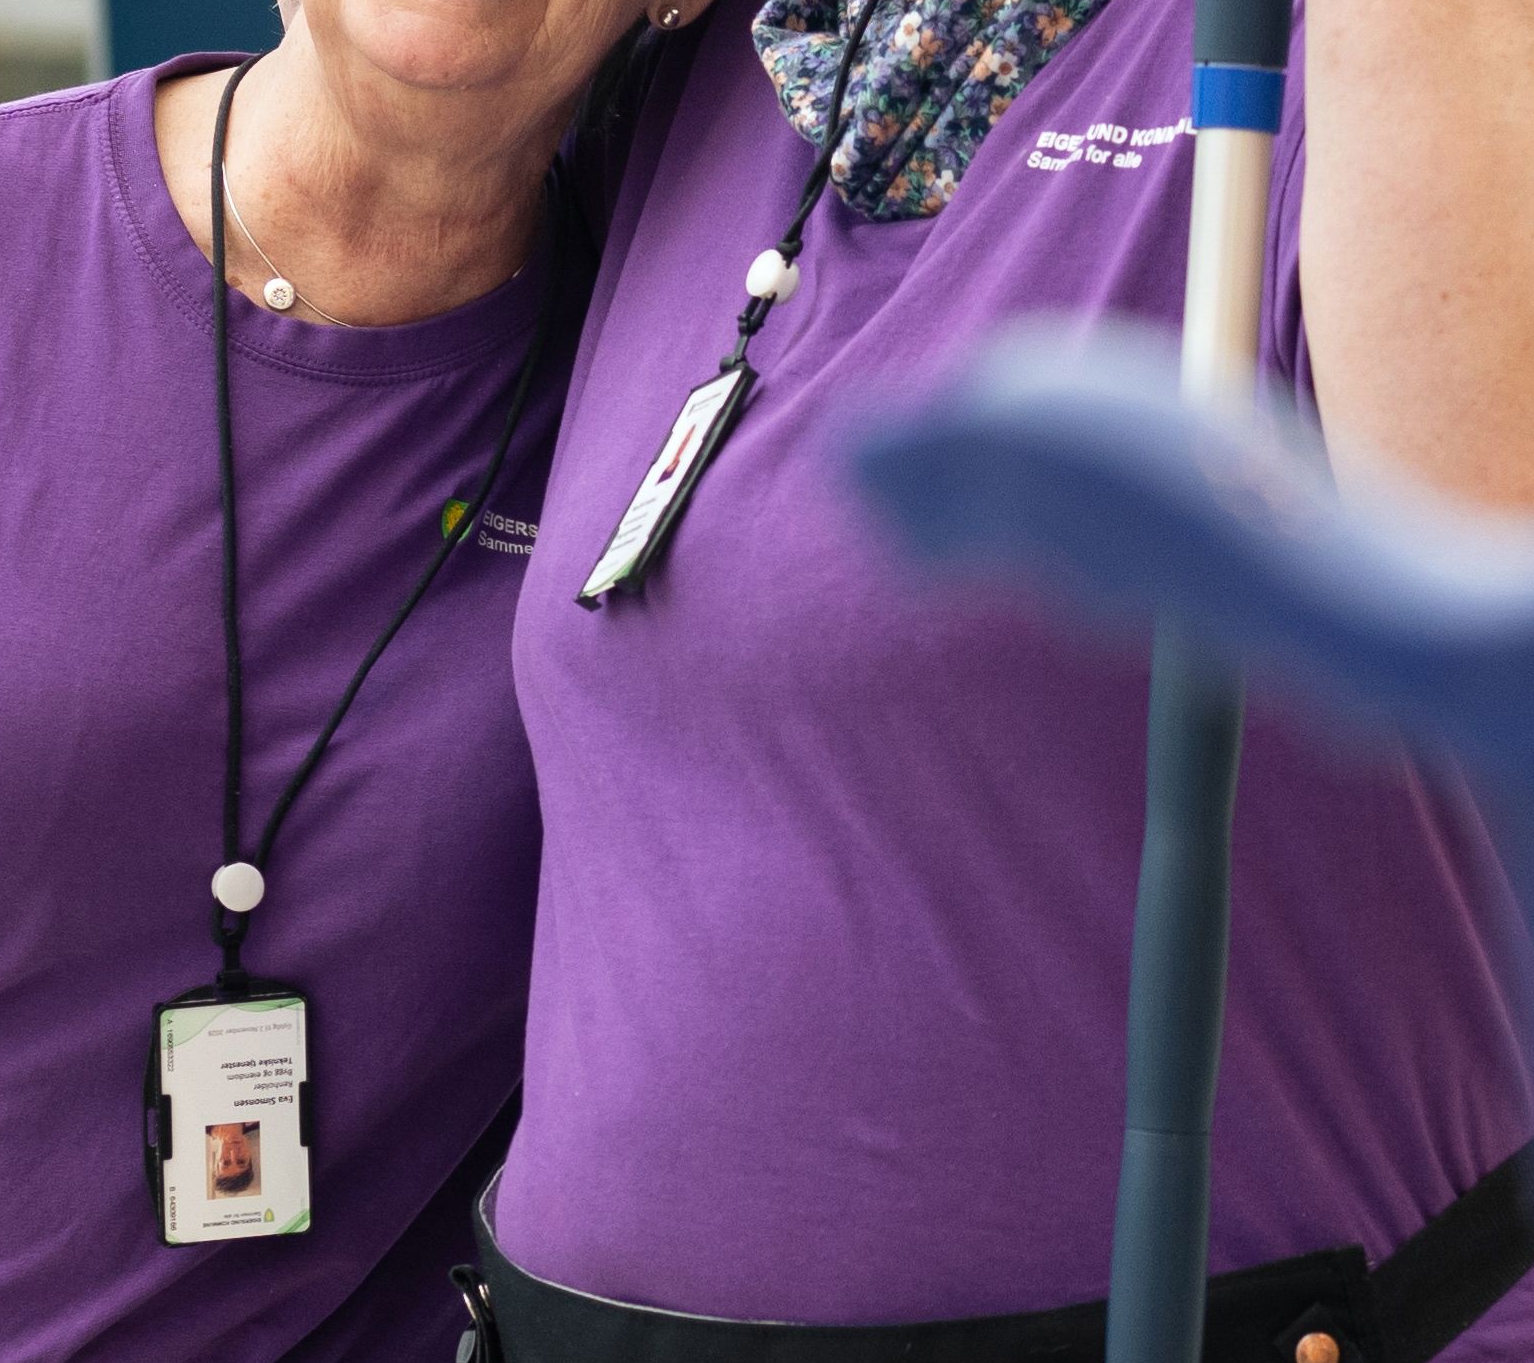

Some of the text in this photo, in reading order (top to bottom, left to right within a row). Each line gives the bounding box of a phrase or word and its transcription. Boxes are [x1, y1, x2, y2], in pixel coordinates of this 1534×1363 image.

[1085, 144, 1112, 164] for
[1113, 151, 1142, 168] alle
[258, 1057, 292, 1067] Tekniske
[278, 1095, 293, 1104] Eva
